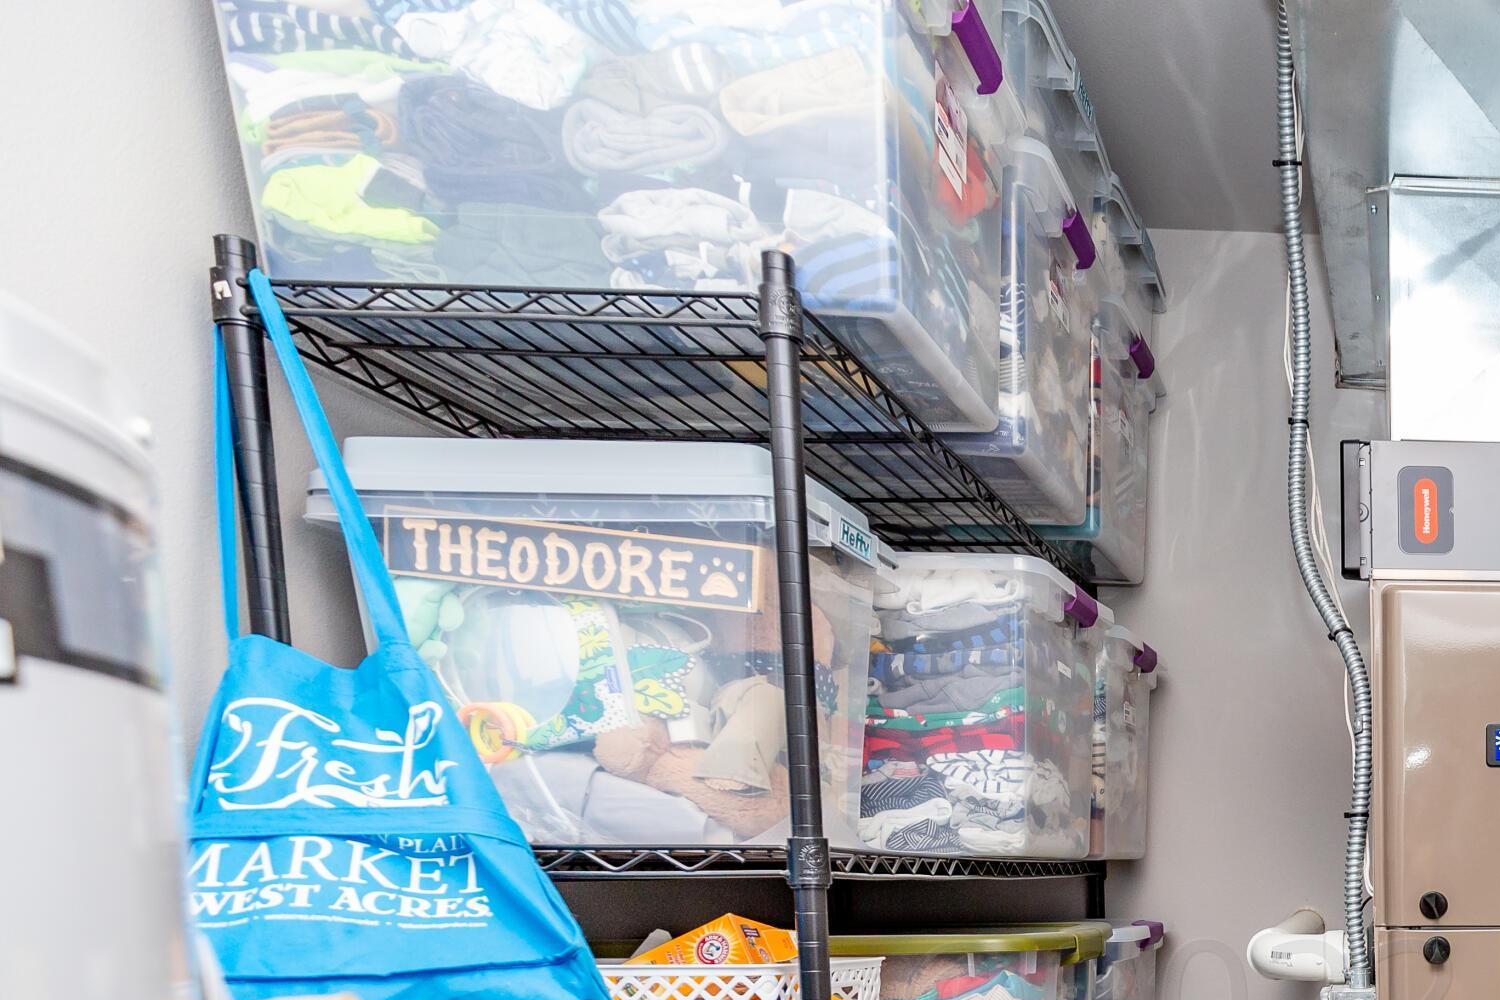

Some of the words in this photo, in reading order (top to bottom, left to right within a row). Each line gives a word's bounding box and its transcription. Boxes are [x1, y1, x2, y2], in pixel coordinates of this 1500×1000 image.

[1421, 488, 1431, 534] Honeywell
[402, 518, 694, 598] THEODORE
[841, 523, 870, 560] Hefty
[190, 883, 321, 916] WEST
[328, 887, 494, 918] ACRES
